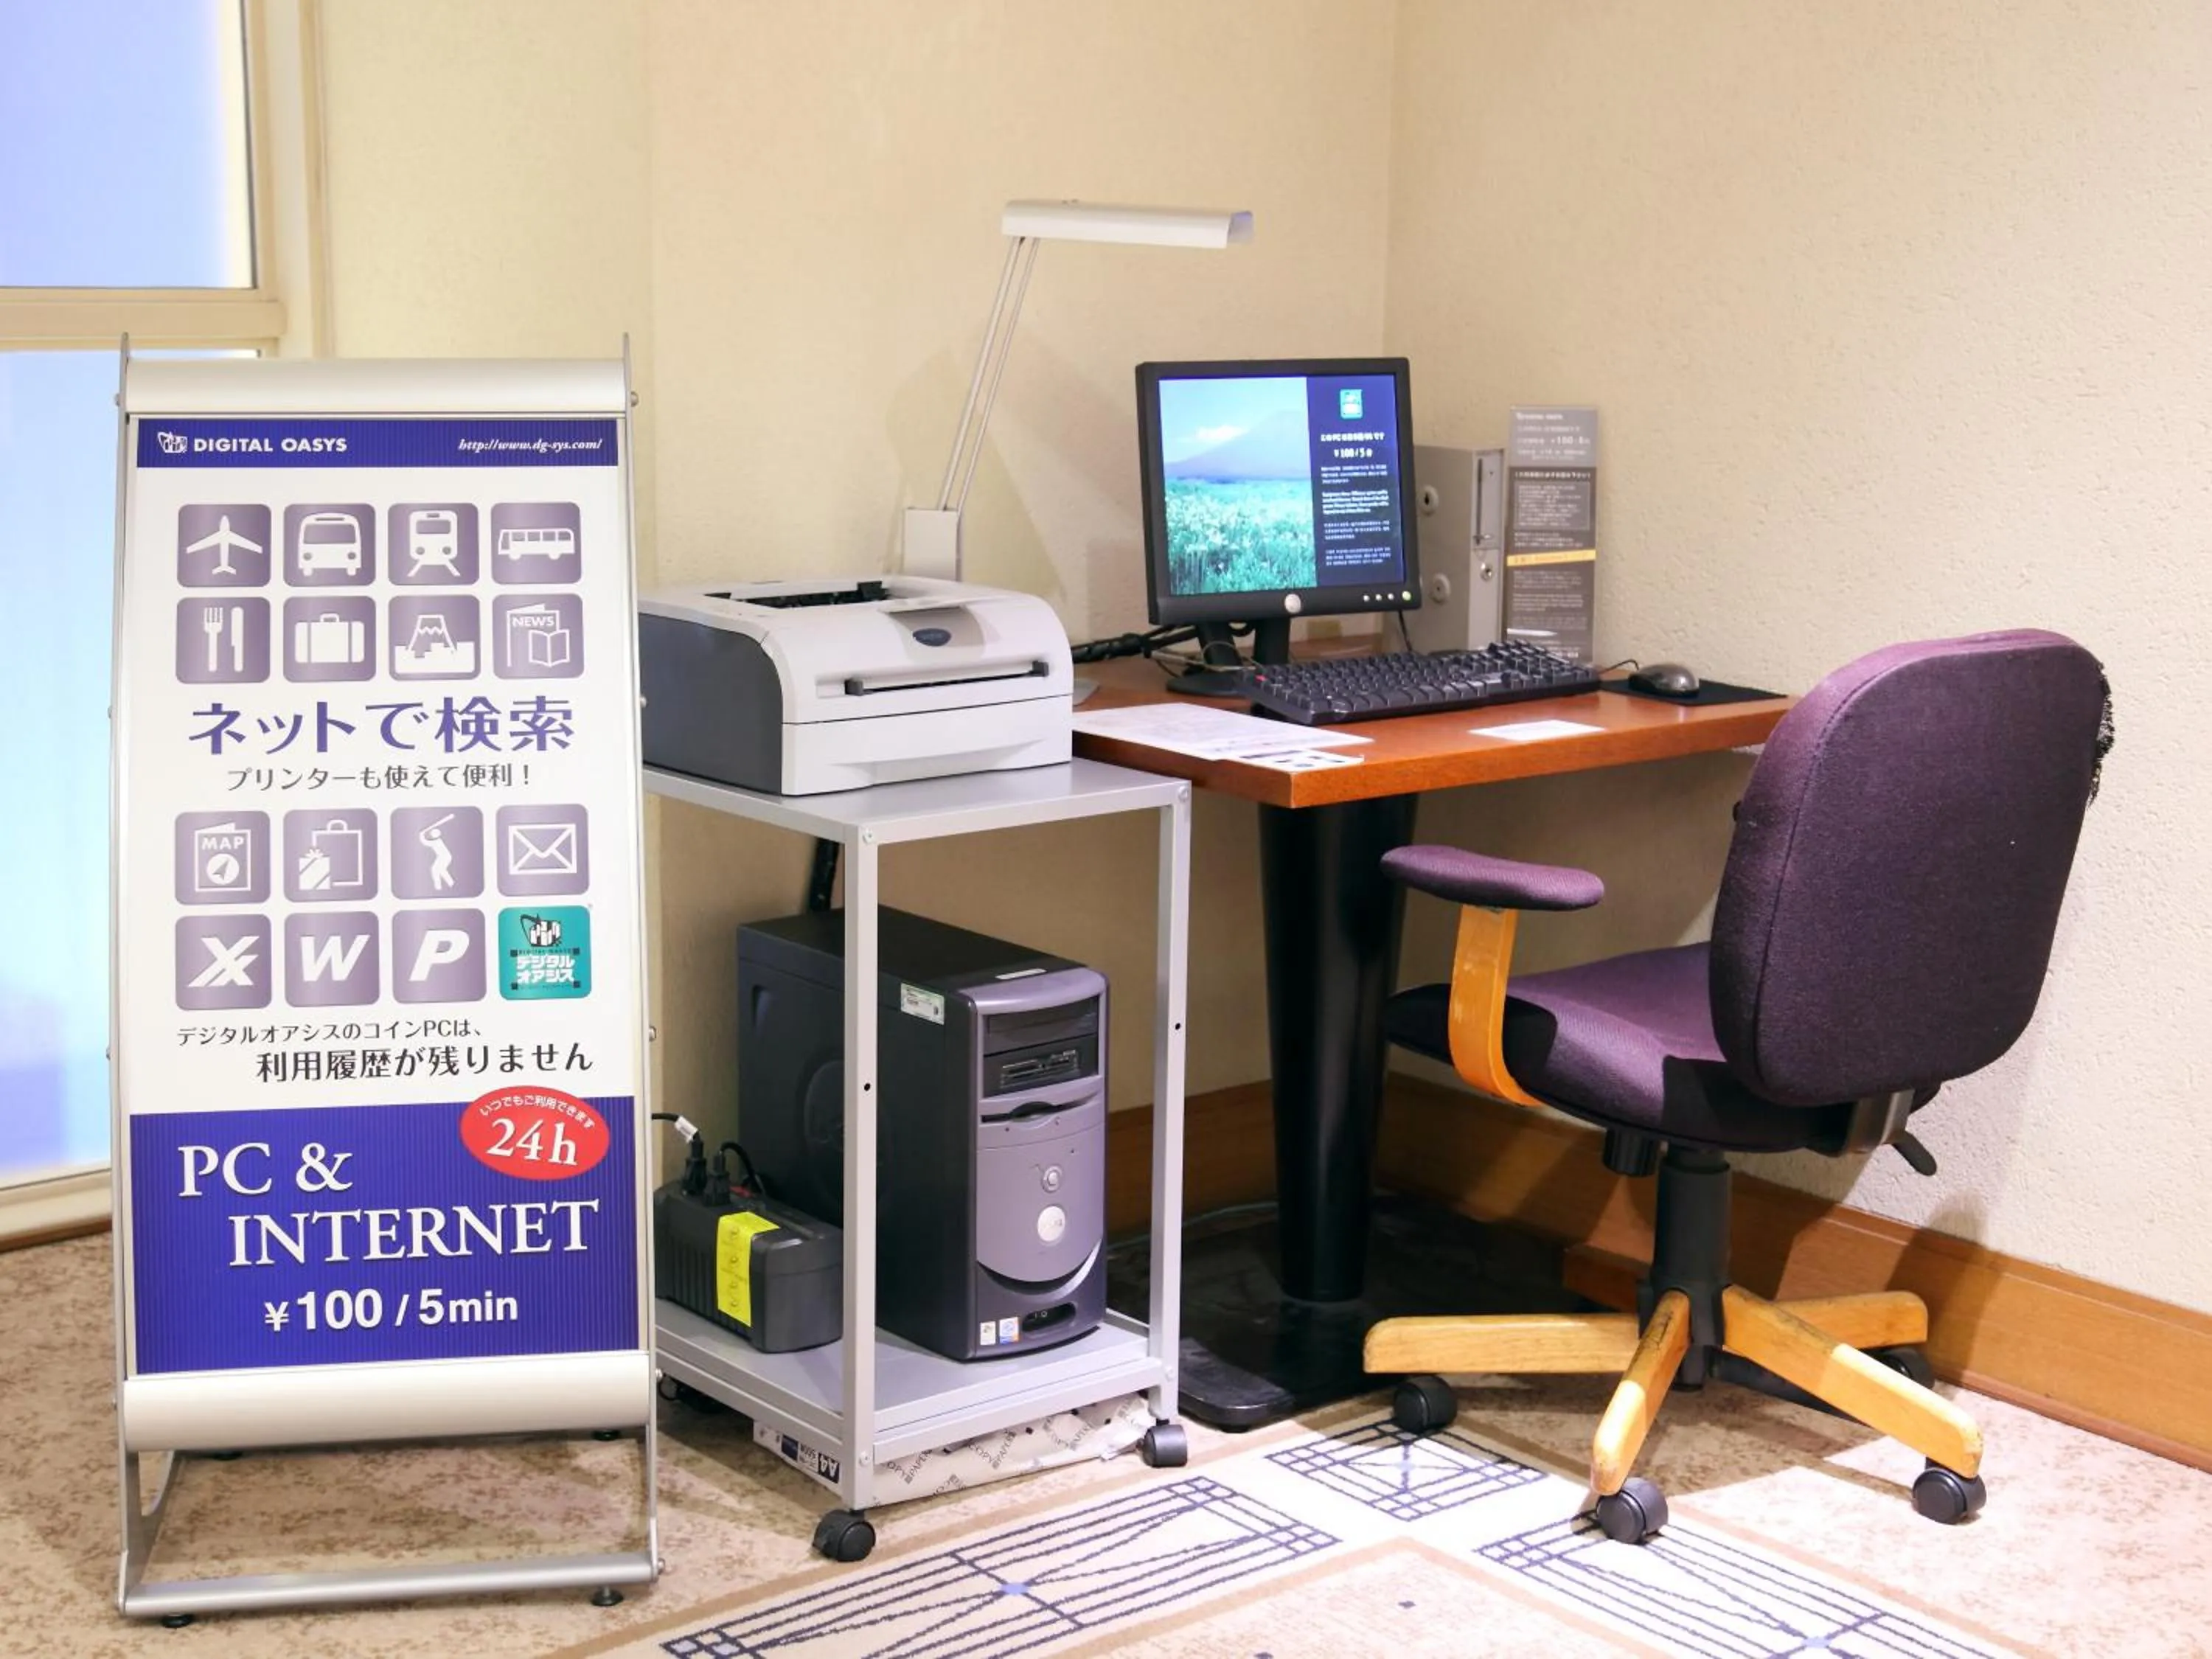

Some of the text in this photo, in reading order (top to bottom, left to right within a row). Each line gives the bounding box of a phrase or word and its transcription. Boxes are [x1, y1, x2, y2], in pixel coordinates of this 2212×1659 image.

[194, 437, 348, 452] DIGITAL OASYS
[458, 438, 602, 453] http://www.dg-sys.com/
[512, 614, 554, 628] NEWS
[188, 695, 575, 755] ネットで検索
[201, 835, 245, 852] MAP
[300, 934, 369, 983] W
[409, 930, 469, 982] P
[516, 953, 576, 970] デジタル
[516, 969, 575, 984] オアシス
[177, 1020, 481, 1046] デジタルオアシスのコインPCは、
[256, 1042, 594, 1082] 利用履歴が残りません
[480, 1094, 596, 1129] いつでもご利用できます
[486, 1117, 577, 1166] 24h
[178, 1142, 354, 1197] PC &
[229, 1198, 600, 1267] INTERNET
[819, 1455, 839, 1478] A4
